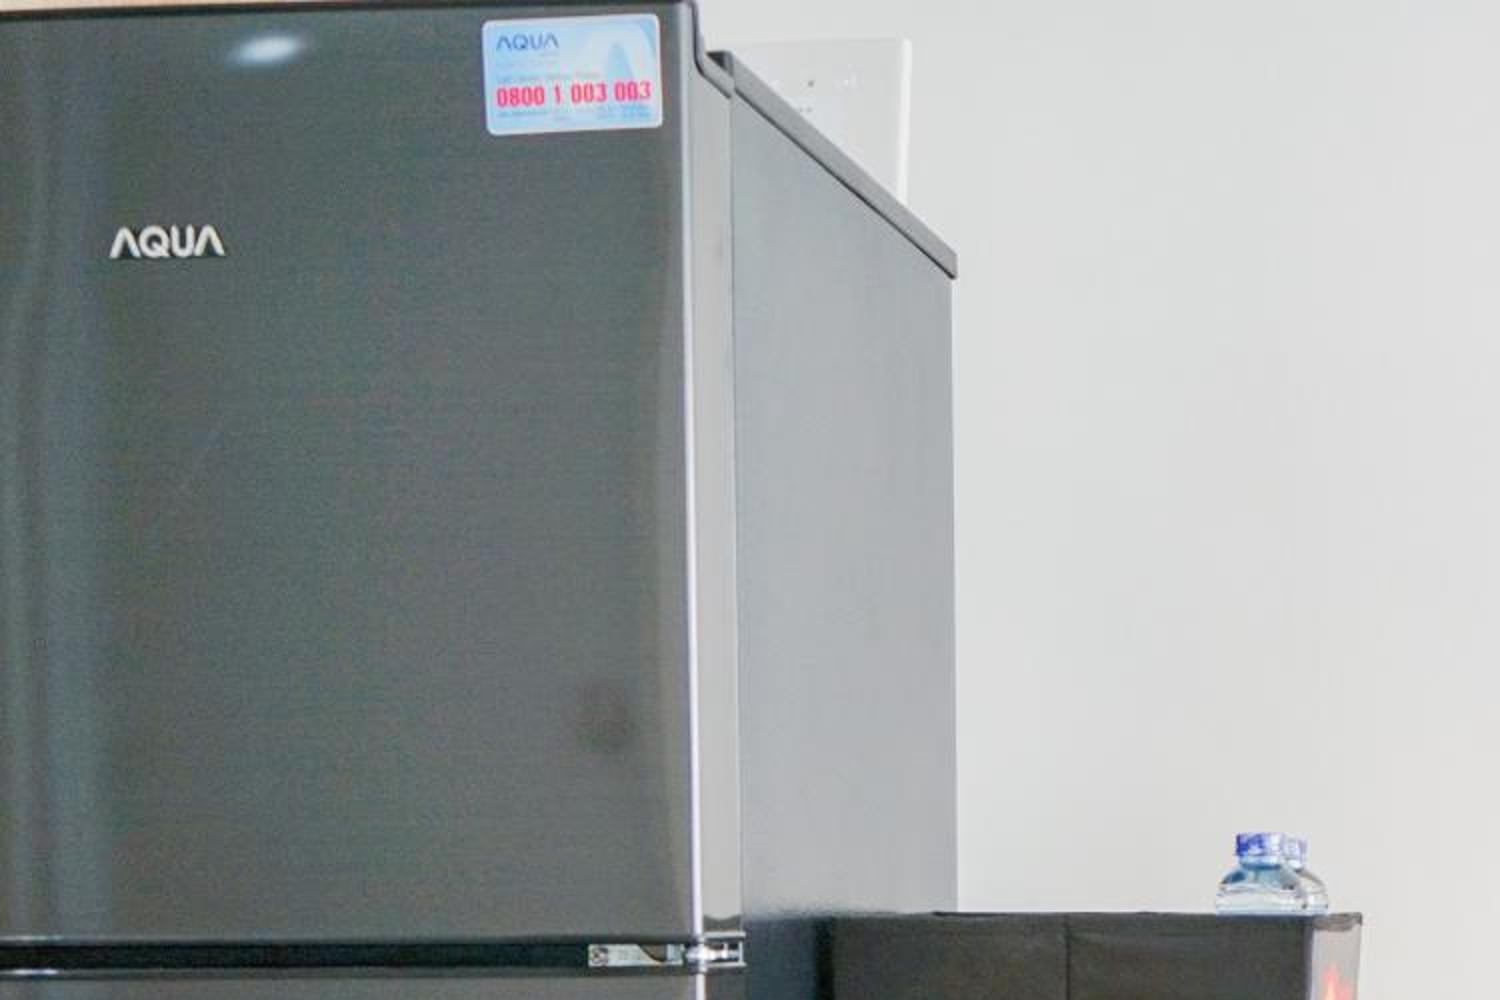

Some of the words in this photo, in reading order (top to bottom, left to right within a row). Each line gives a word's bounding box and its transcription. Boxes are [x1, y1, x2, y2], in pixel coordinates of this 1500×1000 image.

[496, 32, 559, 49] AQUA
[496, 86, 545, 107] 0800
[554, 86, 562, 104] 1
[571, 82, 607, 104] 003
[614, 81, 651, 102] 003
[109, 225, 225, 258] AQUA
